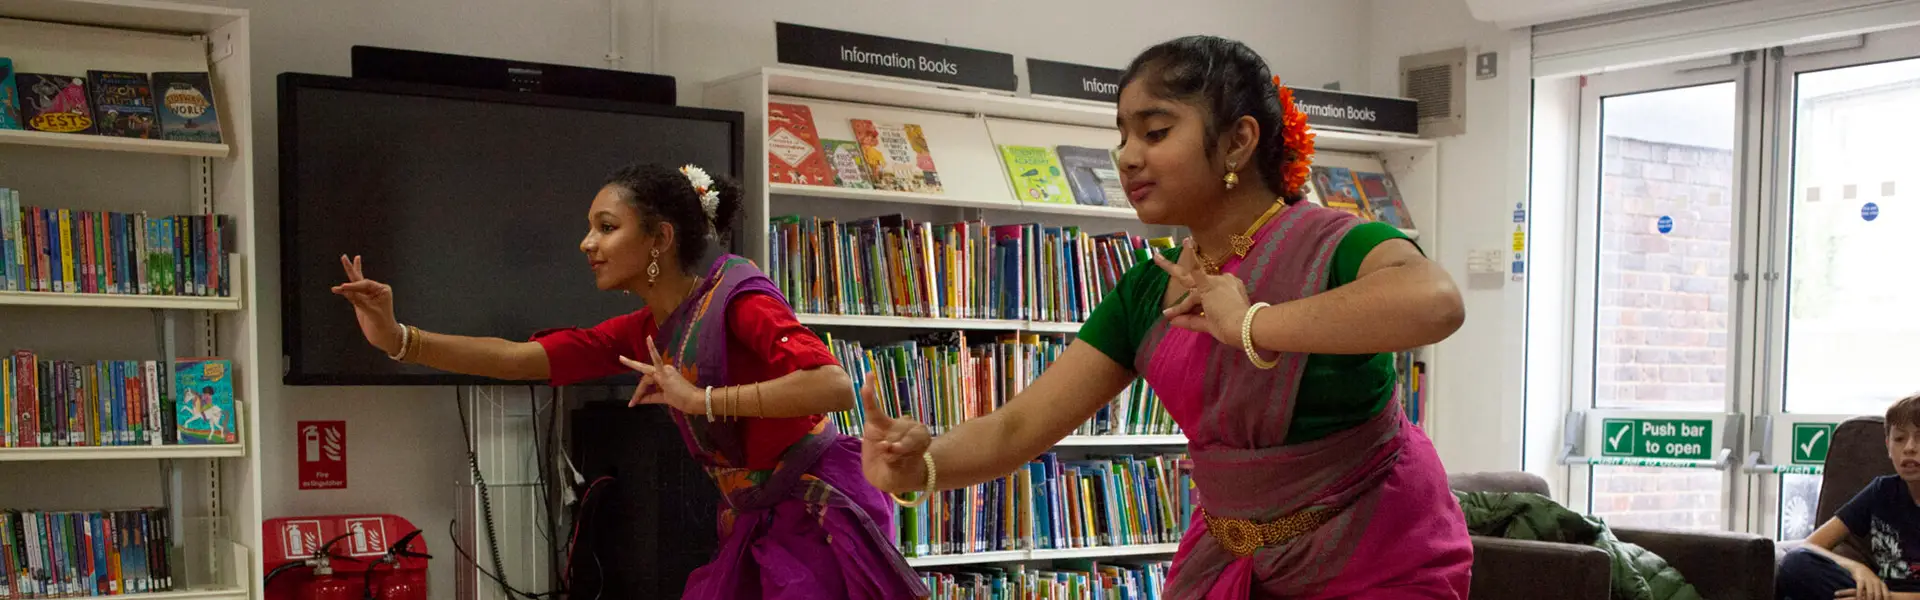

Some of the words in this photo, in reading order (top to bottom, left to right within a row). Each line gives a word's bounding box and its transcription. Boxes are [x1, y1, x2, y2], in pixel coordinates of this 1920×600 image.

[841, 45, 916, 70] Information
[919, 55, 958, 76] Books
[1082, 77, 1119, 94] Inform
[1292, 100, 1346, 119] nformation
[1347, 105, 1376, 122] Books
[32, 114, 90, 128] PESTS
[1642, 421, 1676, 437] Push
[1681, 422, 1706, 437] bar
[1645, 439, 1660, 454] to
[1665, 442, 1702, 457] open
